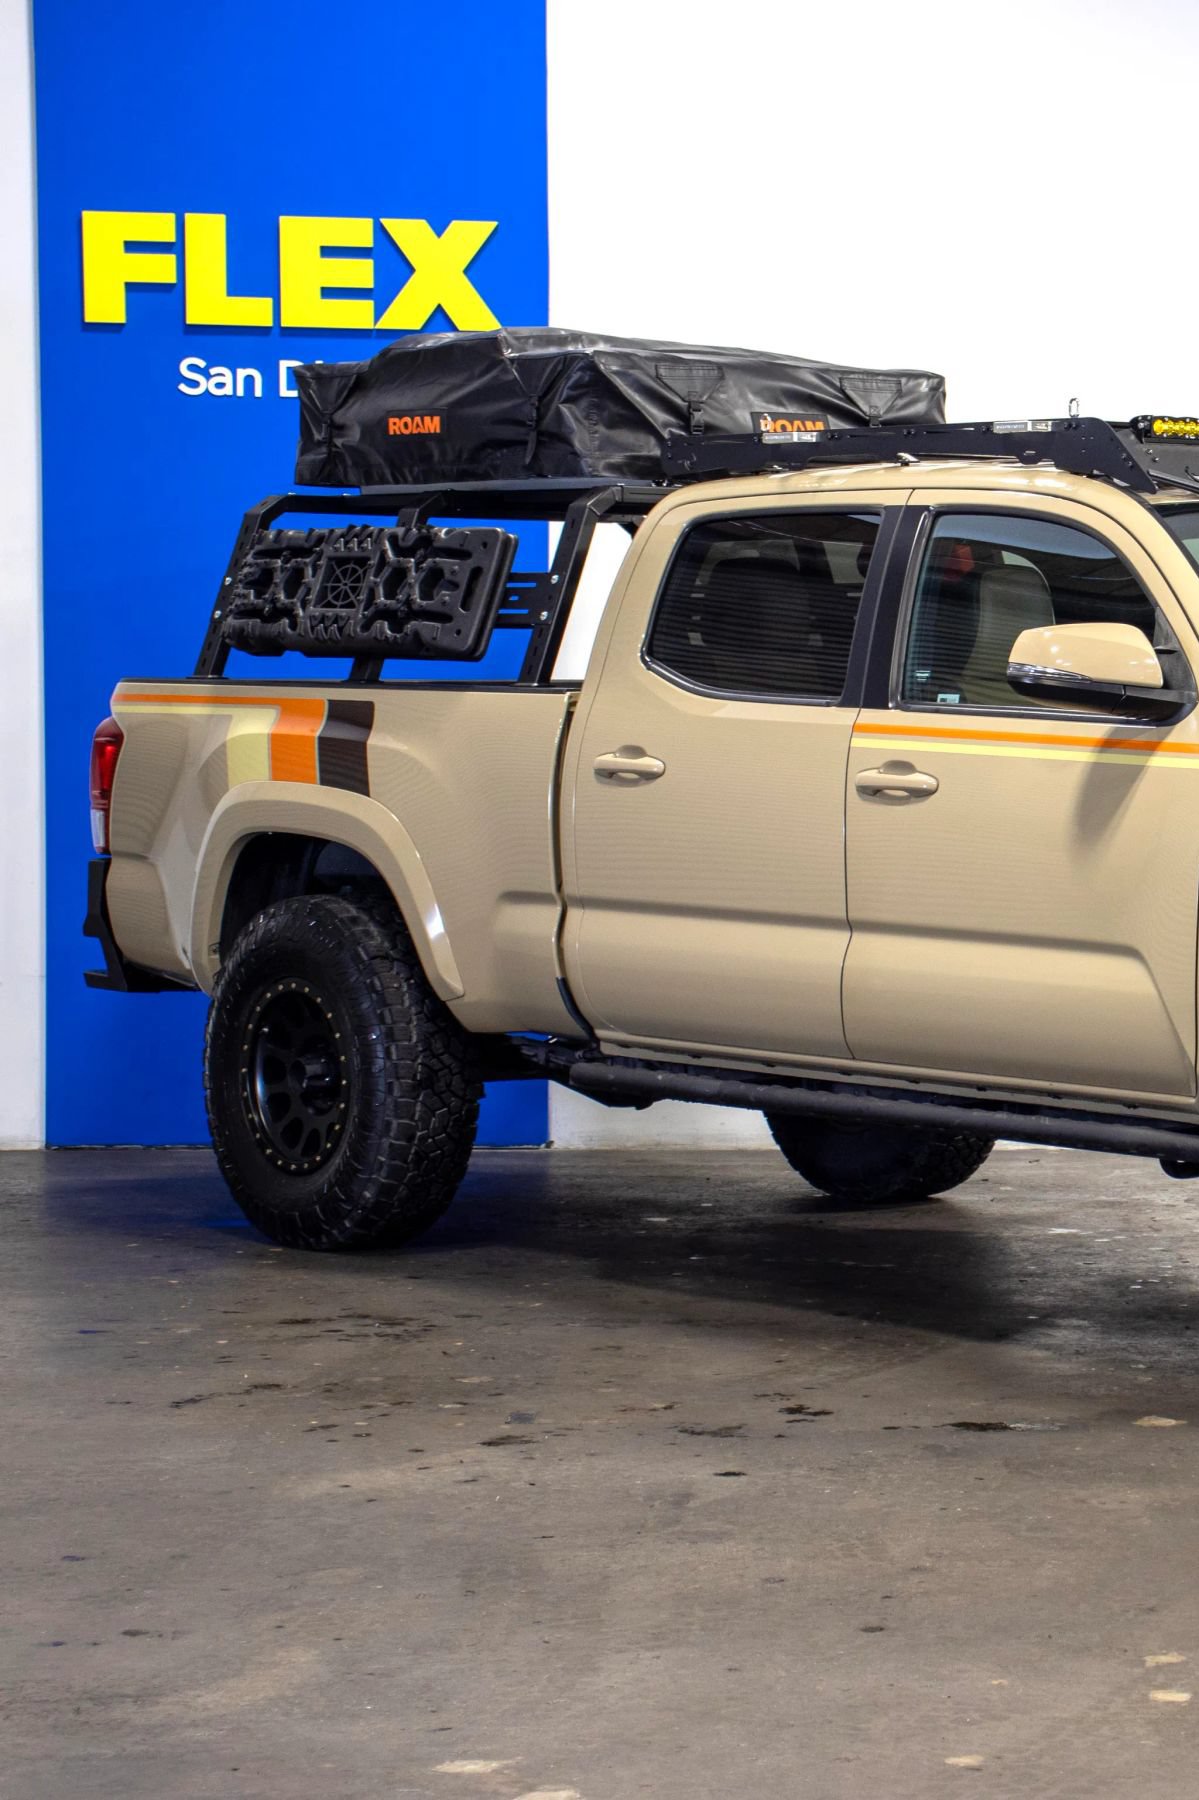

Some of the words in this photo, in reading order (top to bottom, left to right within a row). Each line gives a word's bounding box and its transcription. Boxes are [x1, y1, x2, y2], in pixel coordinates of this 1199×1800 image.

[82, 211, 501, 331] FLEX
[177, 357, 263, 398] San
[387, 415, 441, 435] ROAM
